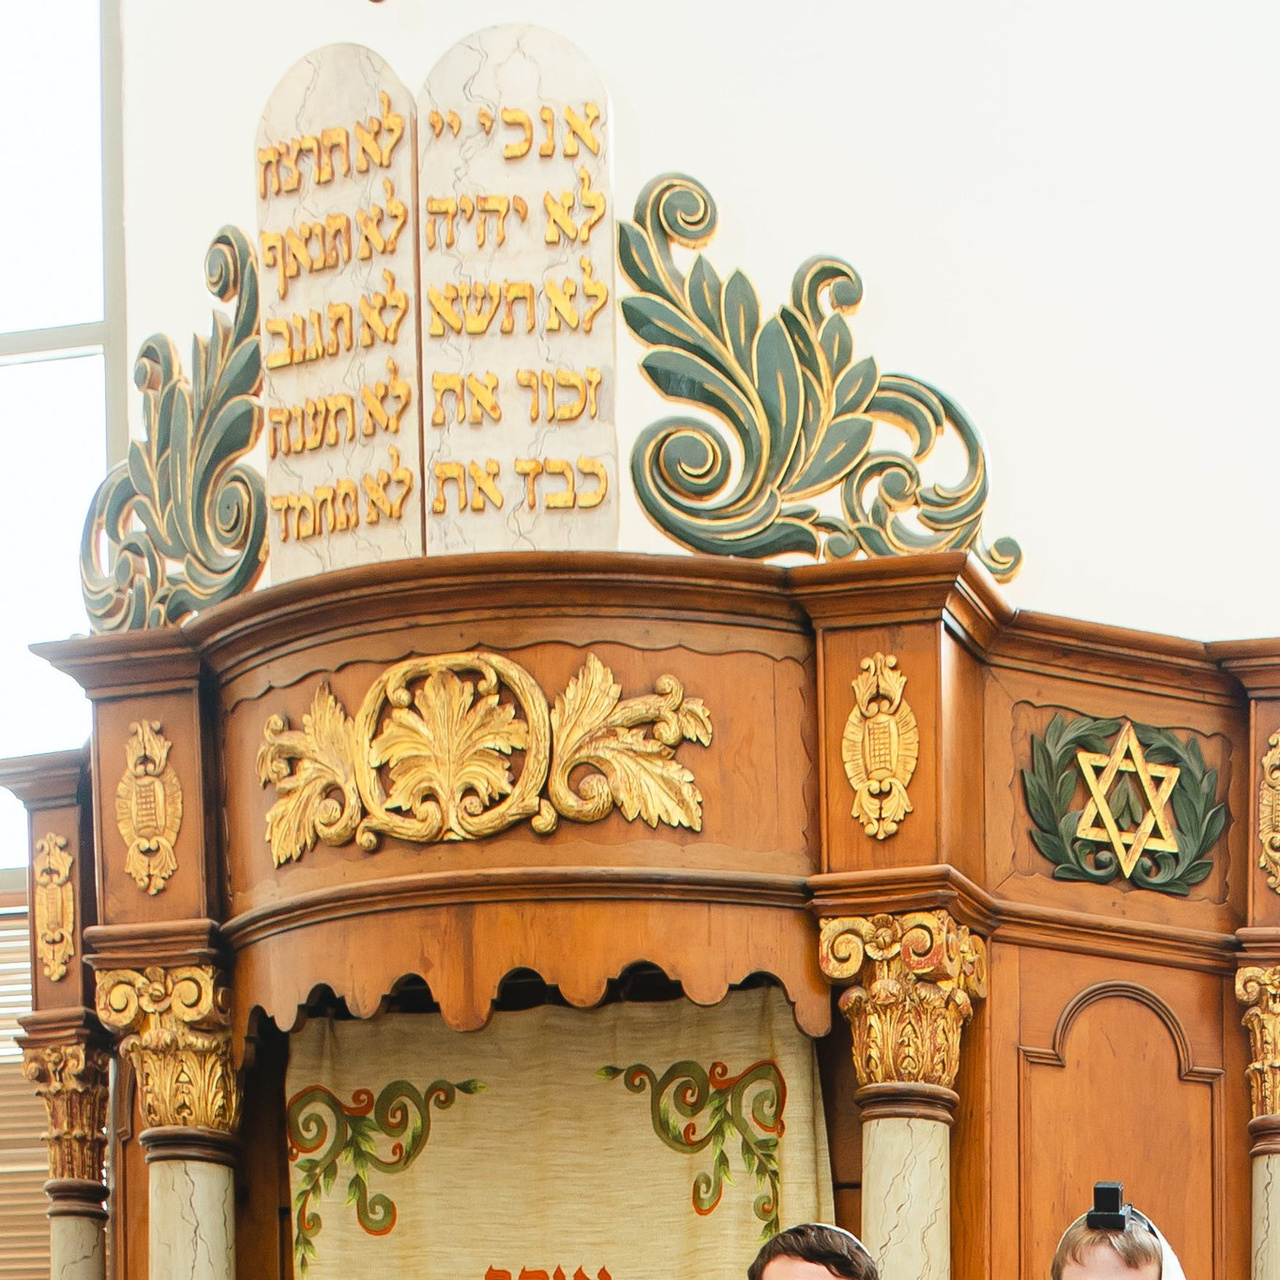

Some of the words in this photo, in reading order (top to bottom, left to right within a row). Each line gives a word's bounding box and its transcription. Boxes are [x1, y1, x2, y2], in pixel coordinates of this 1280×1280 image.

[355, 93, 405, 175] לא
[430, 111, 461, 139] יי
[479, 104, 599, 162] אנכי
[258, 128, 350, 200] תרצח
[357, 179, 408, 262] לא
[427, 195, 528, 251] יהיה
[544, 167, 606, 246] לא
[261, 214, 352, 301] תנאף
[360, 270, 409, 350] לא
[428, 281, 535, 338] תשא
[544, 257, 608, 335] לא
[266, 303, 354, 373] תגנב
[268, 394, 356, 460] תענה
[361, 359, 412, 438] לא
[432, 372, 502, 427] את
[516, 368, 602, 424] זכור
[270, 480, 360, 544] תחמד
[363, 445, 414, 527] לא
[432, 459, 504, 516] את
[514, 458, 608, 512] כבד
